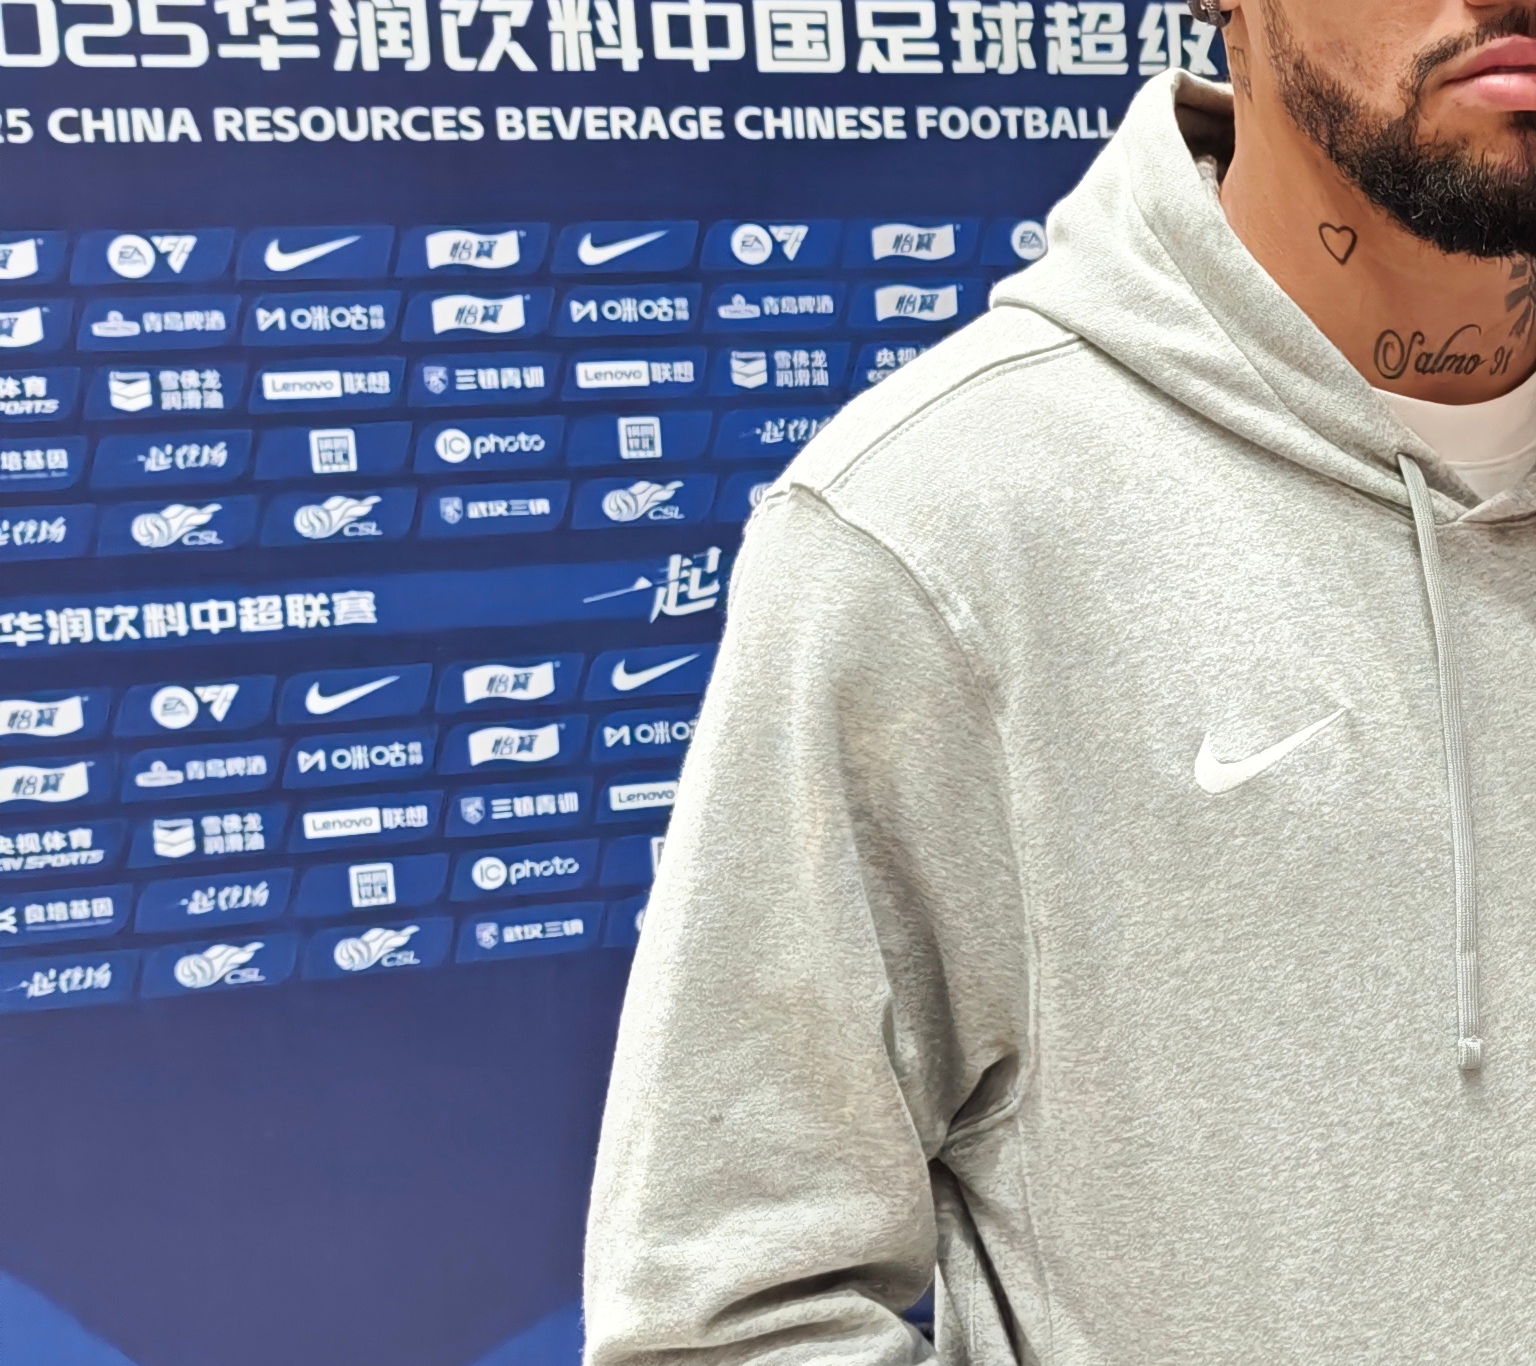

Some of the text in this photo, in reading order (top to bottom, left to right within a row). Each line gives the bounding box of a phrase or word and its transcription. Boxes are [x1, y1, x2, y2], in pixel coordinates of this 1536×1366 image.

[0, 106, 1115, 143] 5 CHINA RESOURCES BEVERAGE CHINESE FOOTBALL
[1374, 323, 1484, 380] Salmo
[583, 369, 643, 381] Lenovo
[271, 379, 334, 392] Lenovo
[474, 432, 545, 459] photo
[648, 505, 685, 520] CSL
[343, 522, 383, 536] CSL
[182, 531, 224, 546] CSL
[0, 591, 377, 646] 华润饮料中超联赛
[619, 788, 675, 803] Lenovo
[311, 815, 373, 833] Lenovo
[509, 857, 579, 884] photo
[381, 952, 420, 967] CSL
[225, 969, 265, 983] CSL
